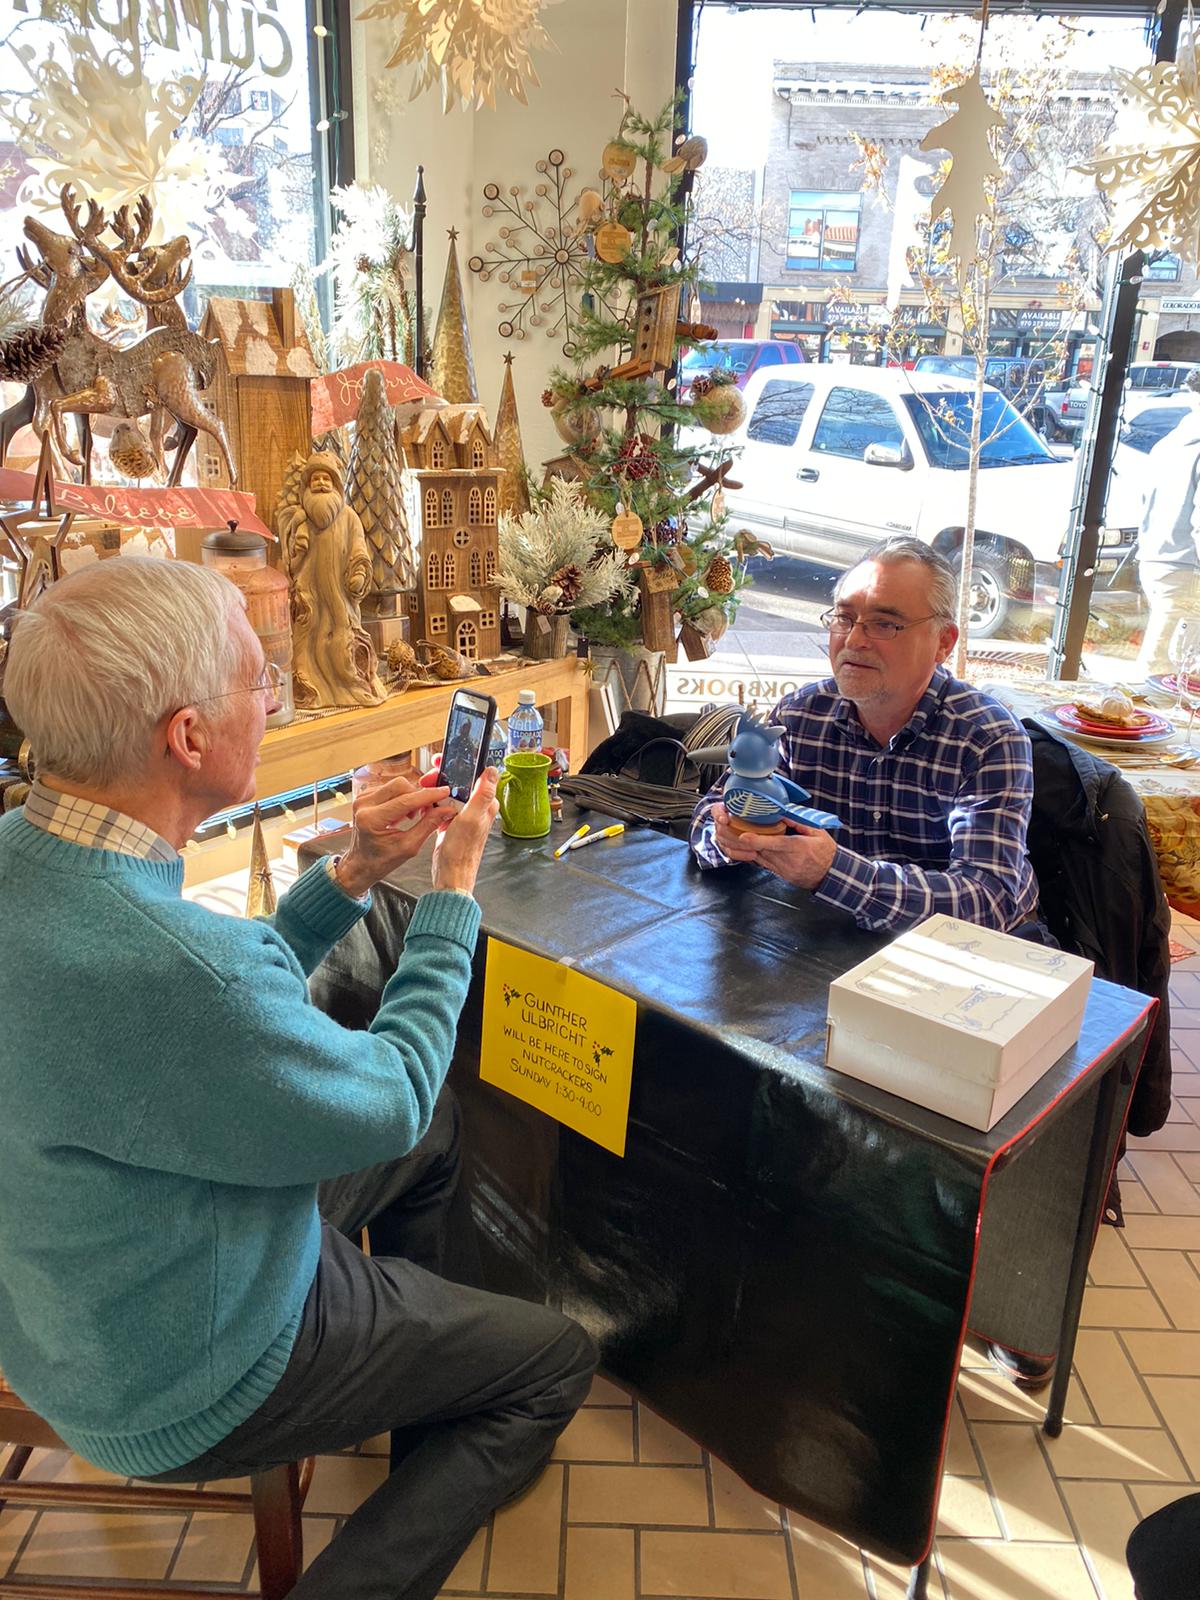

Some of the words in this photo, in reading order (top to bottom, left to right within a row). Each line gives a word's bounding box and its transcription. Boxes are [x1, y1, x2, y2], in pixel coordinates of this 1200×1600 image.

[1021, 312, 1060, 320] AVAILABLE
[56, 489, 196, 520] Believe
[521, 1008, 588, 1047] ULBRICHT
[524, 992, 587, 1032] GUNTHER
[503, 1025, 526, 1043] WILL
[529, 1035, 542, 1050] BE
[544, 1042, 570, 1064] HERE
[572, 1056, 584, 1071] TO
[585, 1063, 608, 1084] SIGN
[510, 1057, 551, 1088] SUNDAY
[522, 1049, 593, 1093] NUTCRACKERS
